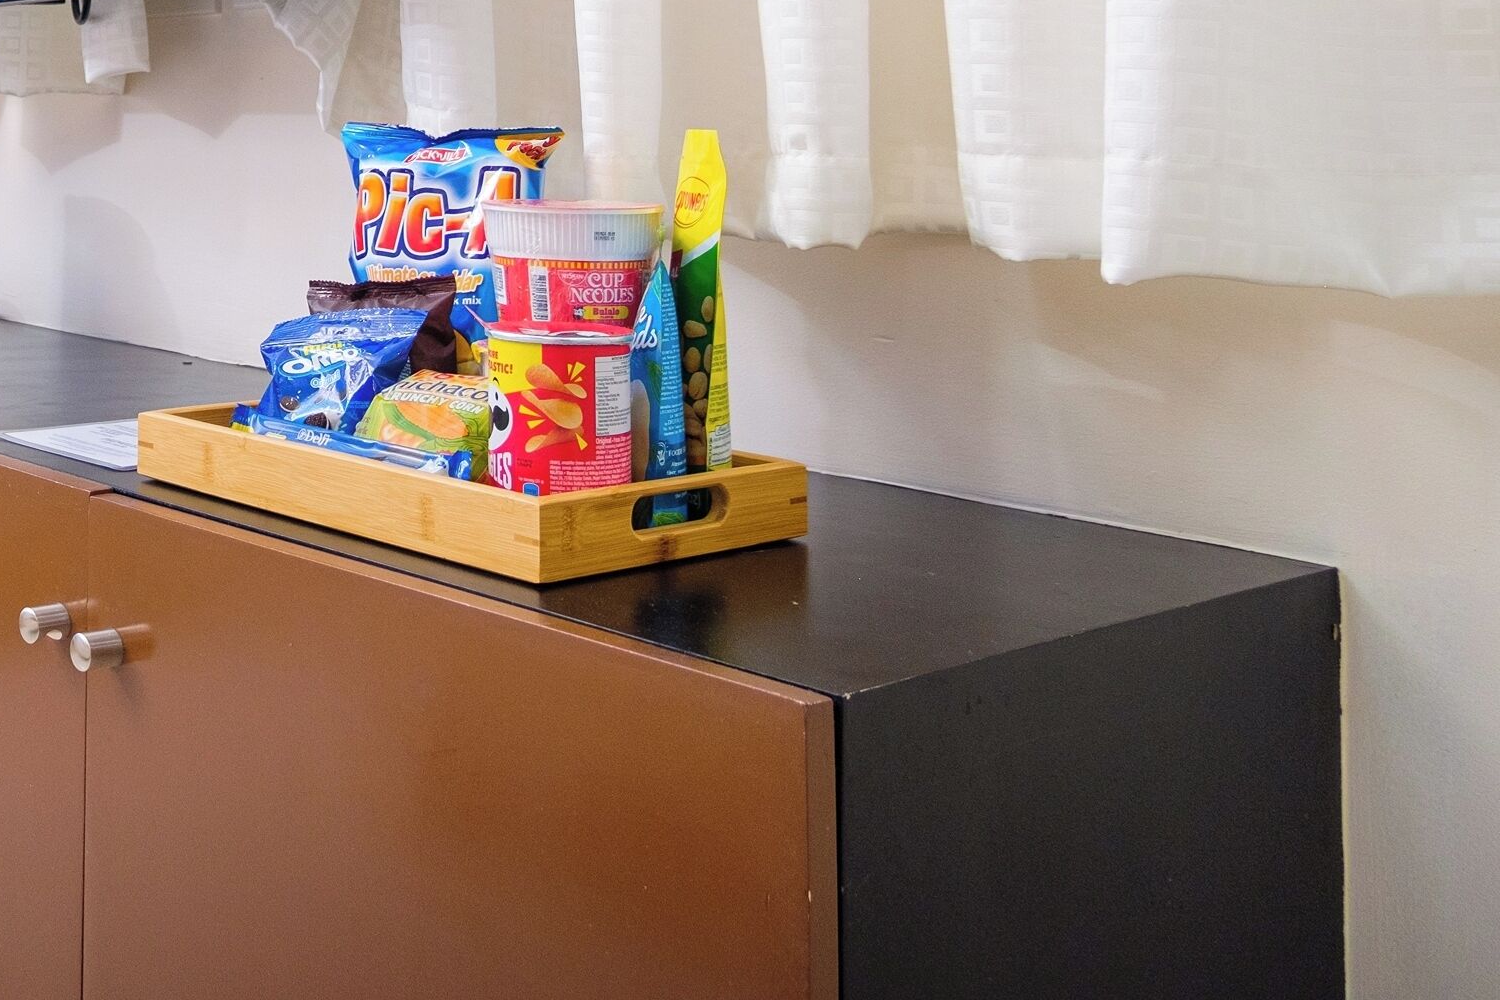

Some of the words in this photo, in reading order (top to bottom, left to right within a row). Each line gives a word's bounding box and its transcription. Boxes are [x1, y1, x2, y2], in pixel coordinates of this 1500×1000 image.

[586, 272, 625, 289] CUP
[462, 295, 482, 306] mix
[569, 286, 634, 304] NOODLES
[281, 348, 360, 375] OREO
[448, 399, 485, 414] CORN
[305, 430, 331, 446] Delfi
